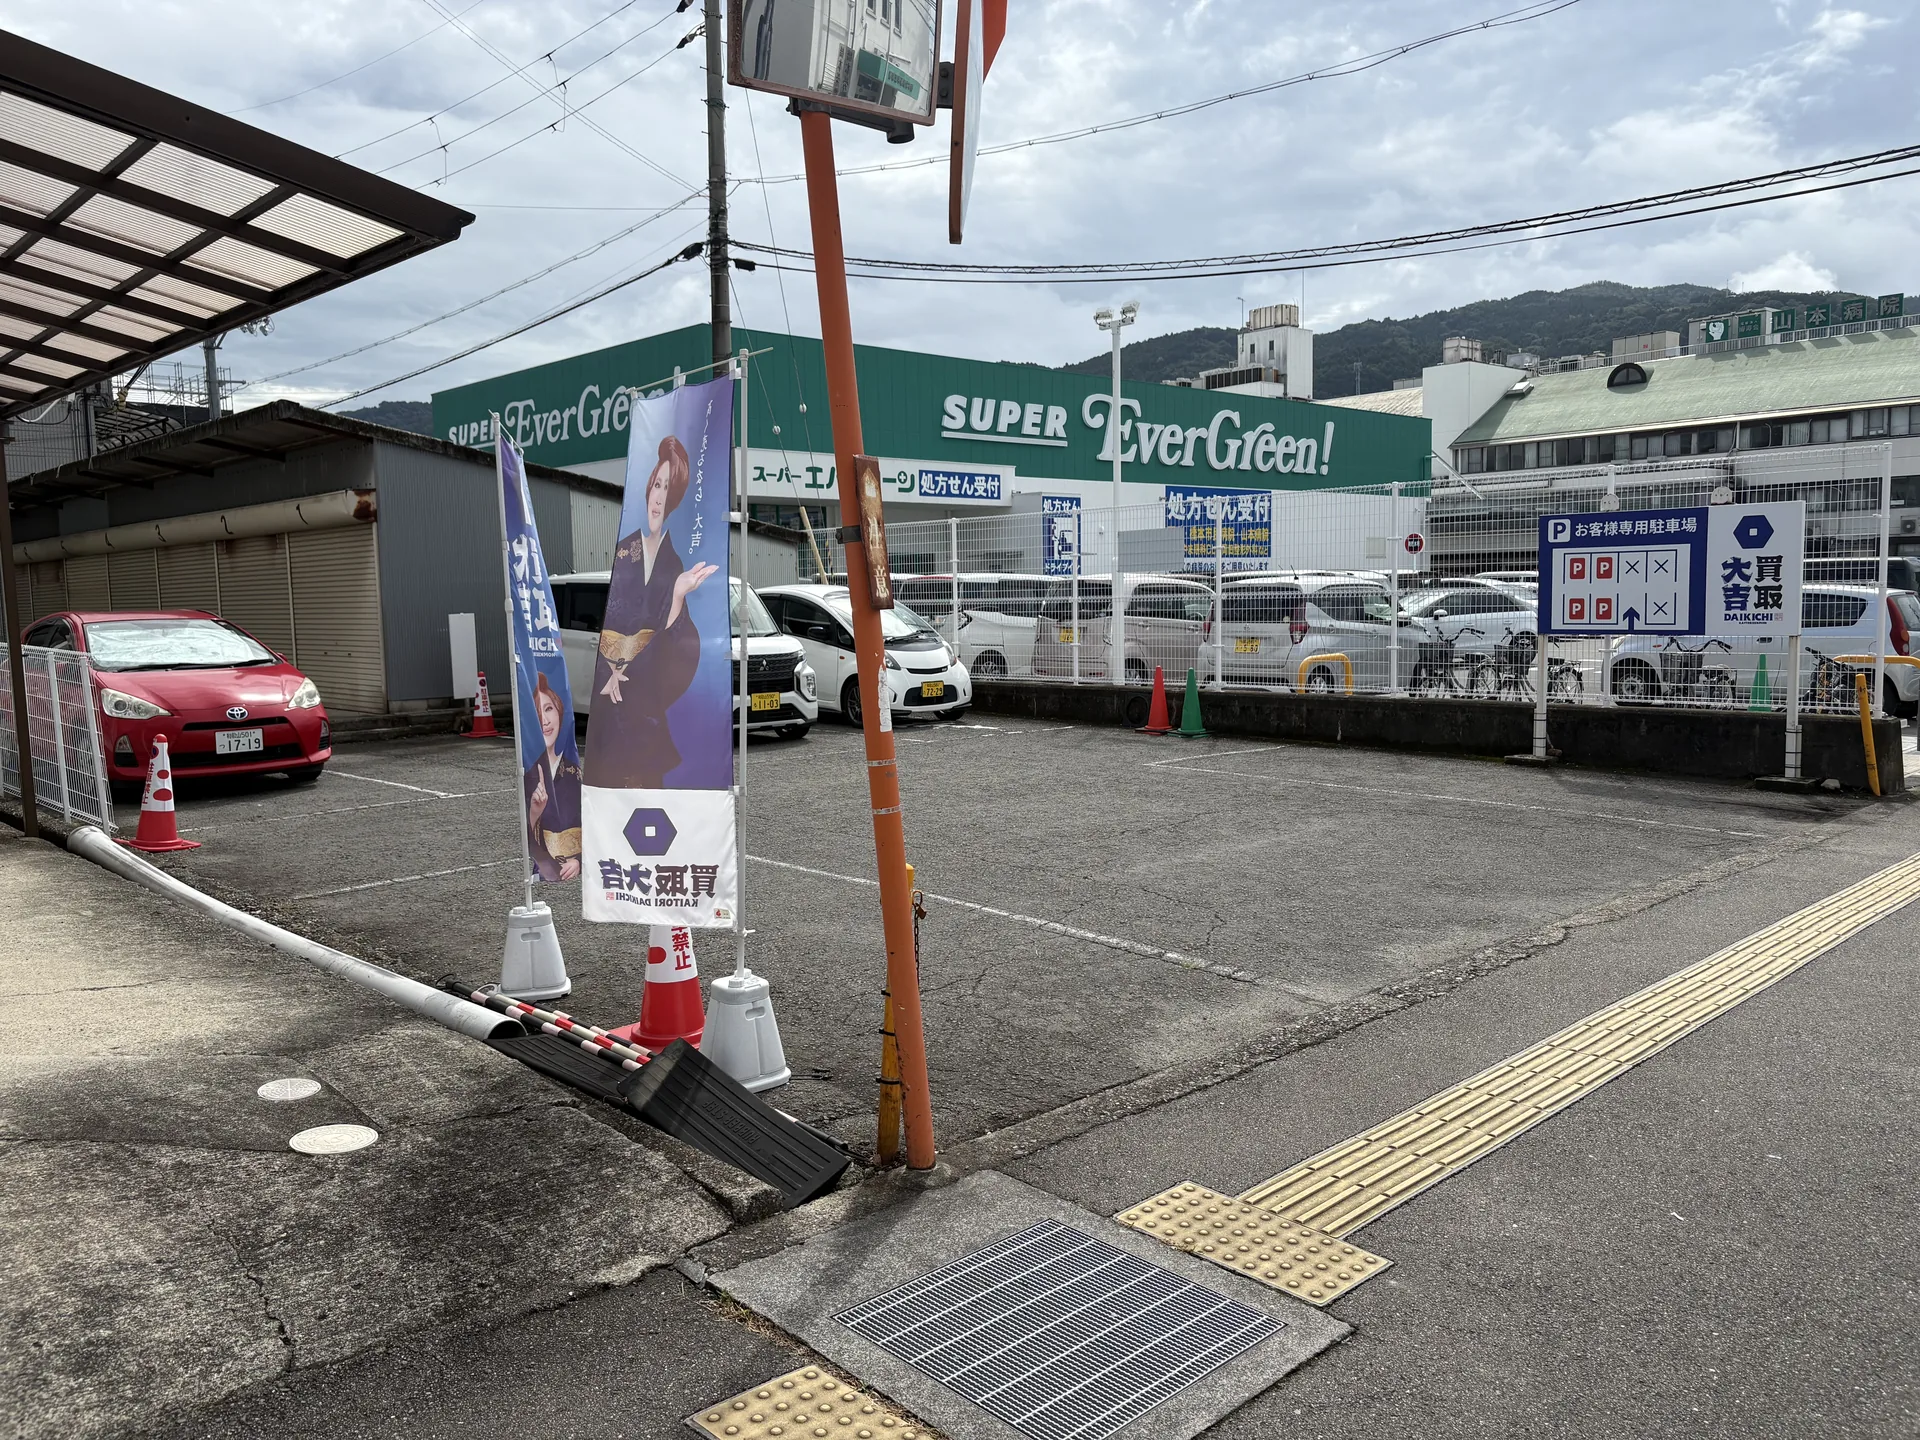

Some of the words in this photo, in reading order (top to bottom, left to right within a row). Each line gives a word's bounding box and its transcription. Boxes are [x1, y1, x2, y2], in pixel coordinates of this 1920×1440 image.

[449, 419, 496, 446] SUPE
[941, 394, 1067, 438] SUPER
[1082, 393, 1335, 476] EverGreen!
[752, 466, 802, 483] スーパー
[920, 472, 1001, 498] 処方せん受付
[1167, 490, 1271, 522] 処方せん受付
[1553, 522, 1567, 540] P
[1575, 517, 1698, 537] お客様専用駐車場
[1573, 562, 1583, 575] P
[1600, 561, 1610, 574] P
[1721, 556, 1753, 611] 大吉
[1754, 555, 1783, 610] 買取
[1572, 602, 1582, 615] P
[1599, 602, 1609, 615] P
[1724, 613, 1773, 622] DAIKICHI
[758, 699, 779, 710] 11-03
[228, 737, 261, 752] 17-19
